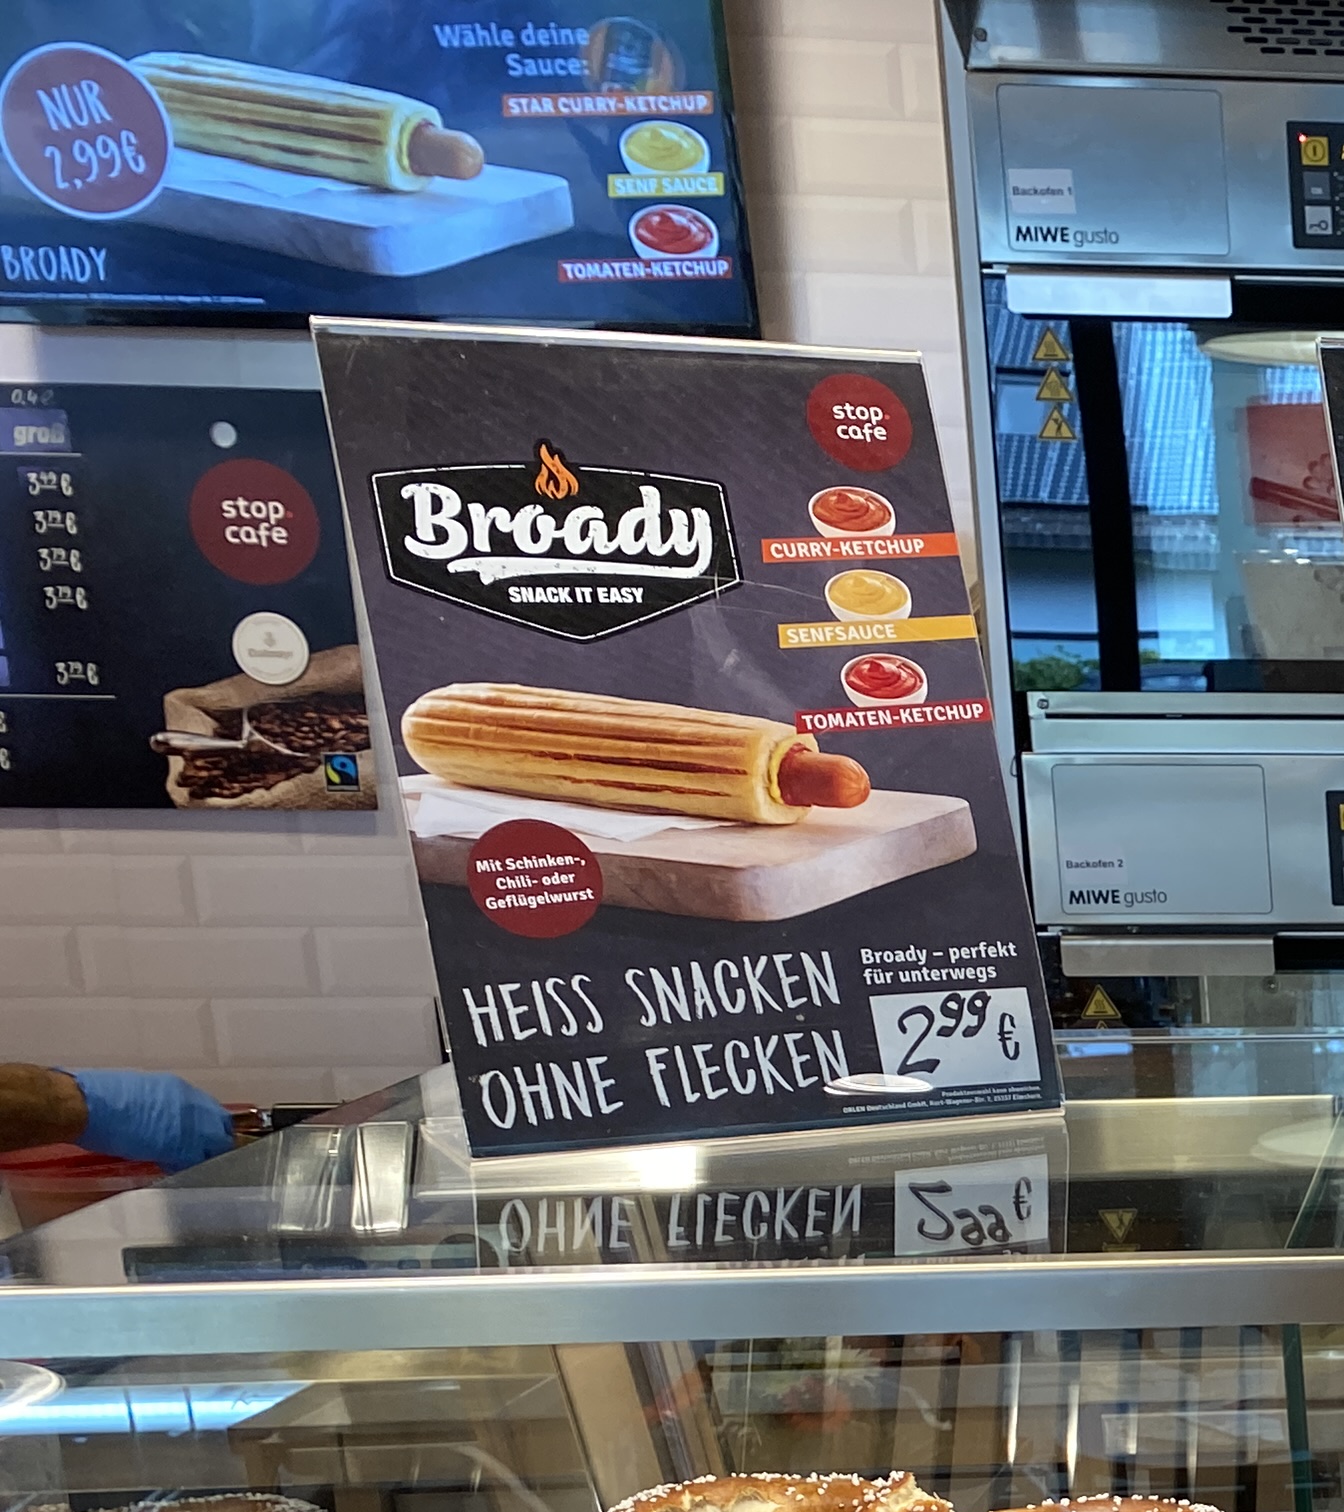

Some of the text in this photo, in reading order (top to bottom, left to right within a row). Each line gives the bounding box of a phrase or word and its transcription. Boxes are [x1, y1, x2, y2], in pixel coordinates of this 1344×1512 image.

[433, 23, 590, 48] Wähle deine
[506, 53, 591, 77] Sauce:
[37, 81, 111, 132] NUR
[508, 95, 708, 114] STAR CURRY-KETCHUP
[46, 135, 146, 190] 2,99€
[616, 175, 717, 195] SENF SAUCE
[1011, 184, 1065, 197] Backofen
[1016, 226, 1119, 247] MIWE gusto
[2, 245, 108, 281] BROADY
[563, 260, 729, 279] TOMATEN-KETCHUP
[832, 403, 884, 424] stop
[836, 421, 888, 443] cafe
[221, 497, 286, 524] stop
[225, 522, 289, 547] cafe
[400, 482, 714, 578] Broady
[770, 538, 925, 559] CURRY-KETCHUP
[508, 586, 644, 604] SNACK IT EASY
[787, 624, 896, 644] SENFSAUCE
[801, 703, 983, 731] TOMATEN-KETCHUP
[475, 852, 586, 874] Mit Schinken-,
[1066, 859, 1123, 869] Backofen 2
[495, 870, 576, 891] Chili- oder
[485, 886, 595, 912] Geflügelwurst
[1069, 889, 1167, 908] MIWE gusto
[860, 942, 1018, 967] Broady perfekt
[862, 964, 997, 986] für unterwegs
[462, 951, 842, 1048] HEISS SNACKEN
[479, 1030, 850, 1130] OHNE FLECKEN
